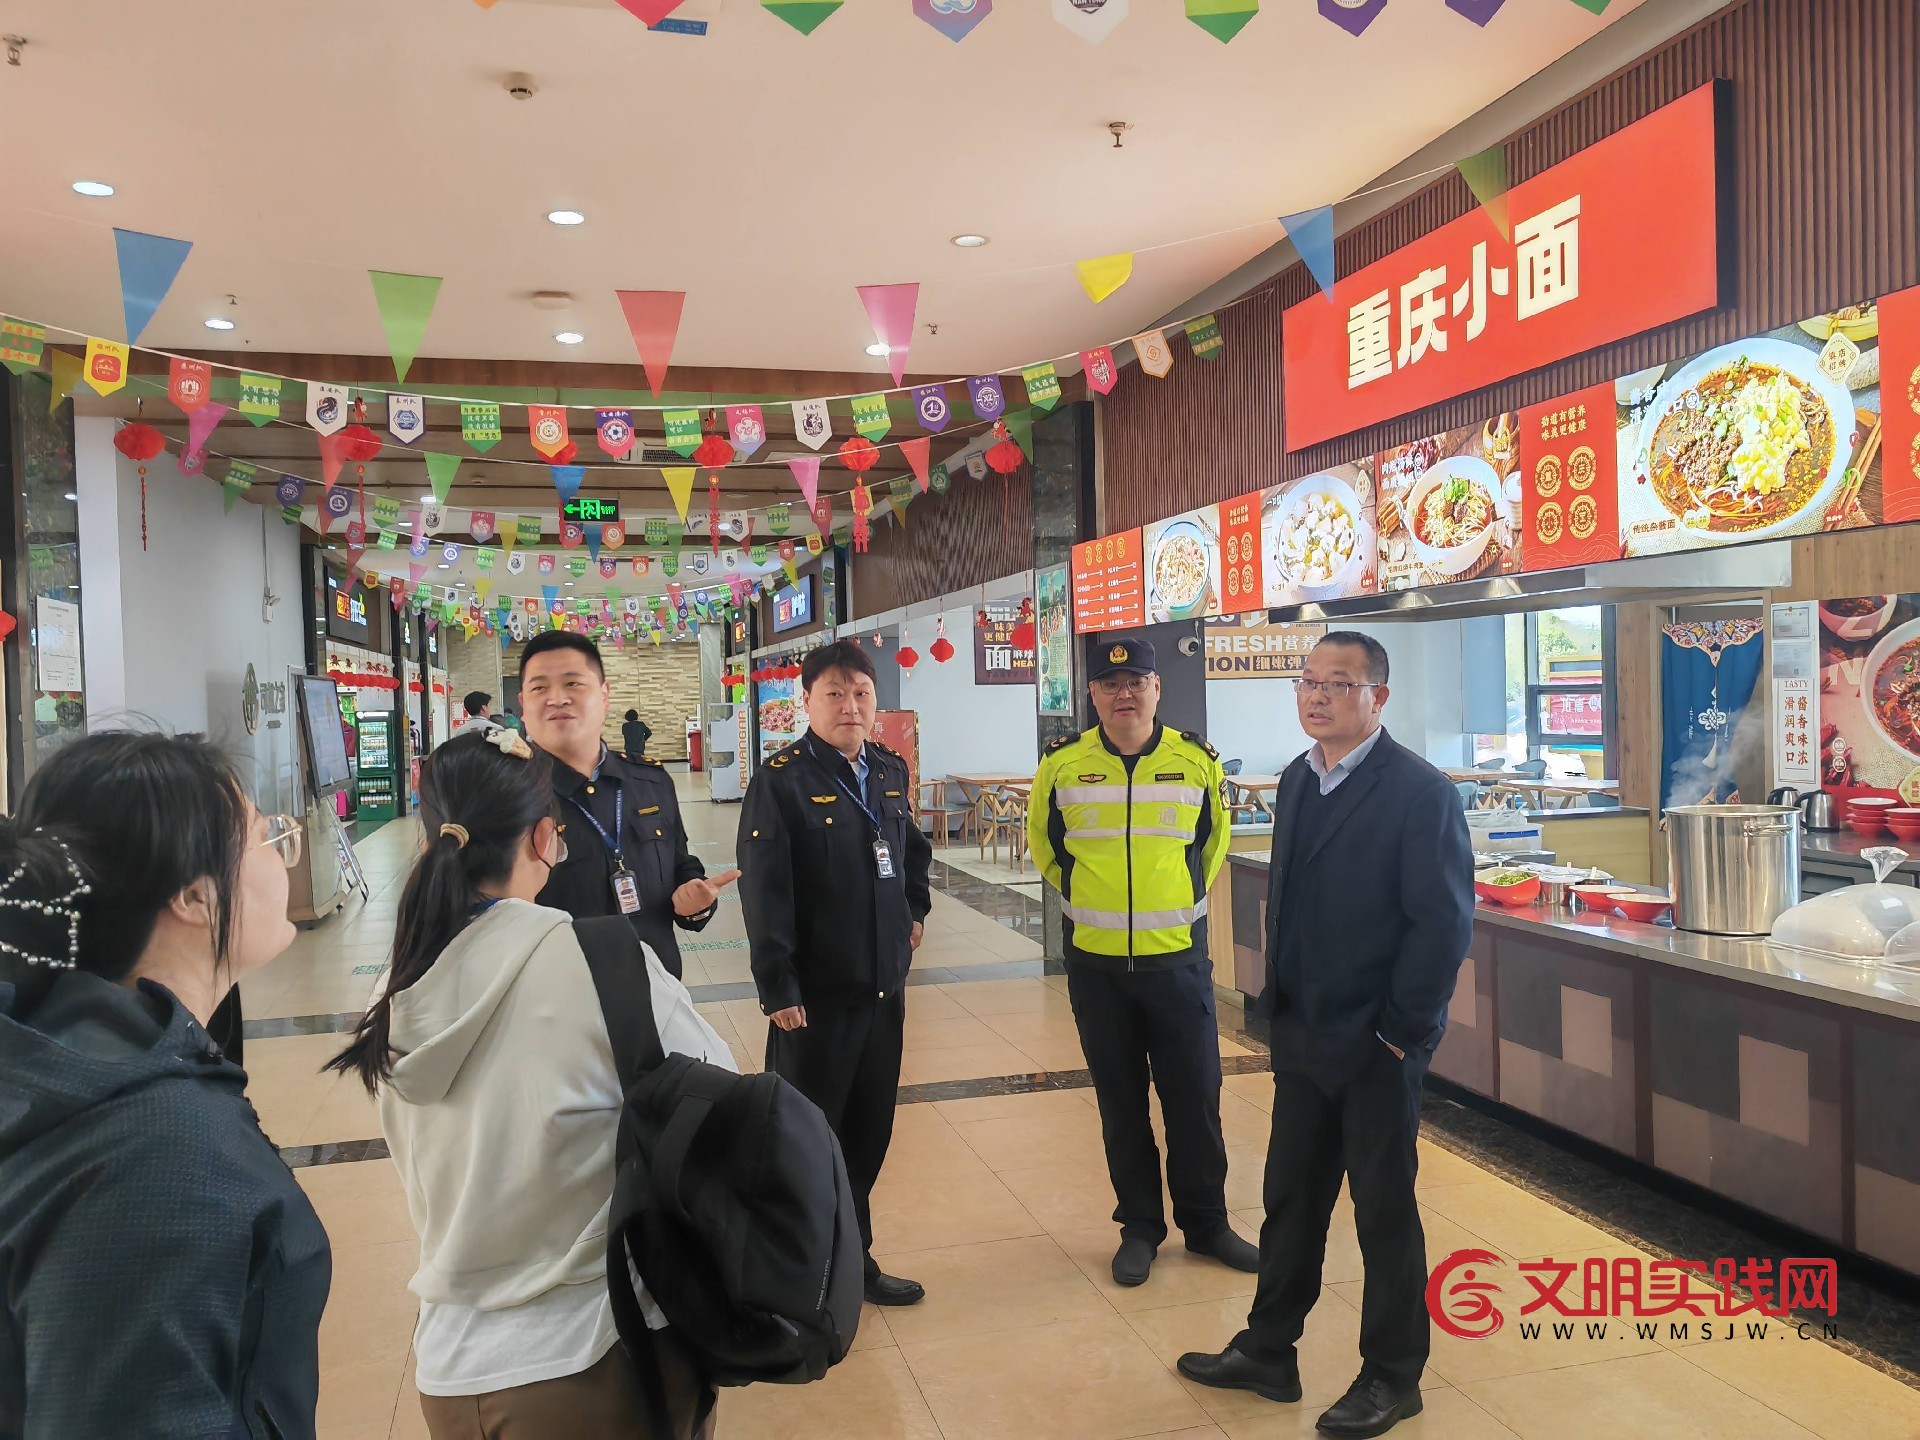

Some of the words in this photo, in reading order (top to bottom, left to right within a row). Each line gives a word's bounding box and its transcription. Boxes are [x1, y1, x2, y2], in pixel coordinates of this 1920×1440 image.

[1347, 194, 1580, 390] 重庆小面
[1541, 403, 1587, 428] 劲道有营养
[1541, 418, 1587, 441] 味美更健康
[1632, 518, 1676, 534] 传统杂酱面
[1205, 634, 1283, 653] FRESH
[1283, 634, 1322, 651] 营养
[984, 644, 1012, 670] 面
[1012, 659, 1036, 668] HEA
[1204, 656, 1251, 672] ION
[1255, 654, 1309, 670] 细嫩弹
[1784, 680, 1808, 689] TASTY
[1784, 696, 1795, 764] 滑润爽口
[1797, 696, 1809, 765] 酱香味浓
[738, 709, 748, 790] DAVANGAR
